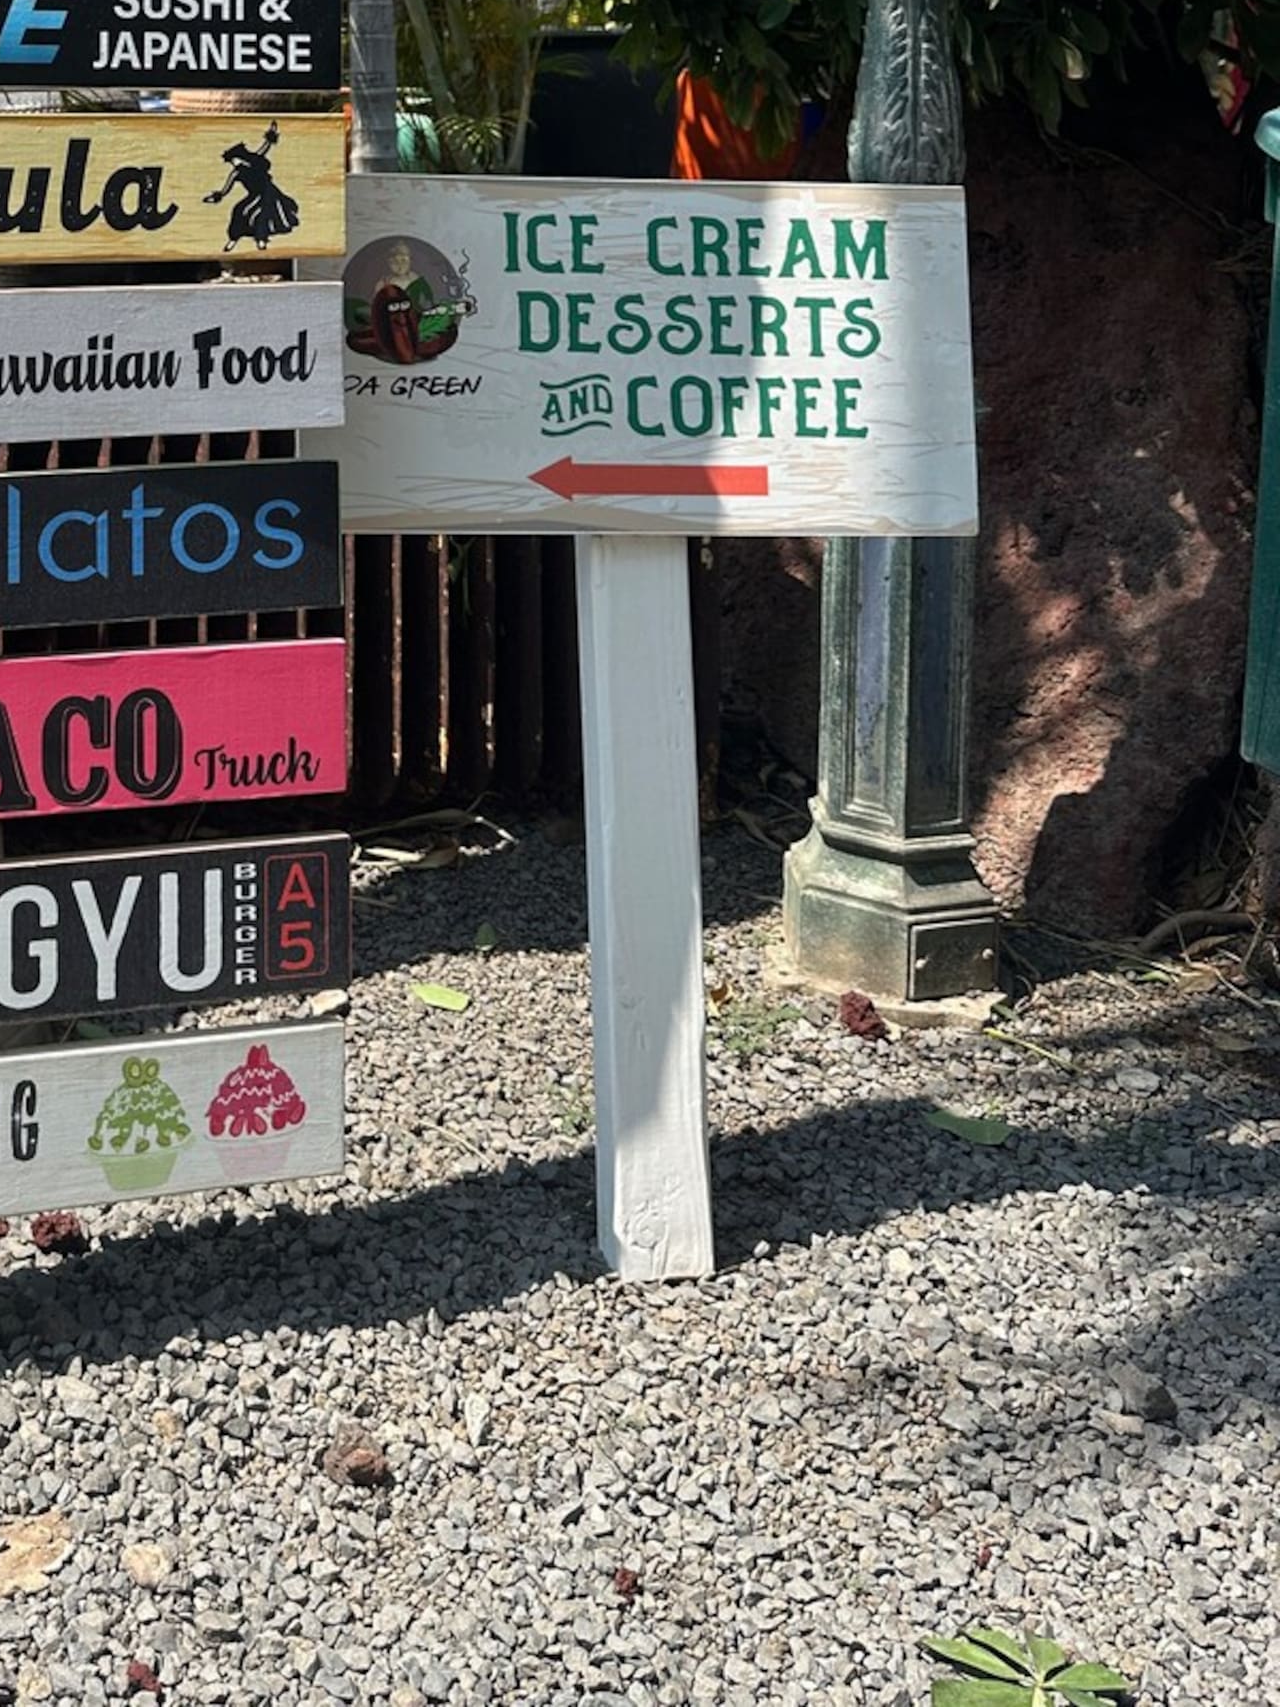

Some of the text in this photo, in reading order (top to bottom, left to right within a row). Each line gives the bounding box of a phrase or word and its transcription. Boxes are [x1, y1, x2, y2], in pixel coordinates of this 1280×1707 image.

[92, 31, 312, 73] JAPANESE
[503, 211, 889, 280] ICE CREAM
[518, 290, 881, 358] DESSERTS
[192, 326, 317, 388] Food
[390, 373, 483, 399] GREEN
[540, 376, 869, 439] AND COFFEE
[193, 737, 320, 792] Truck
[233, 862, 258, 986] BURGER
